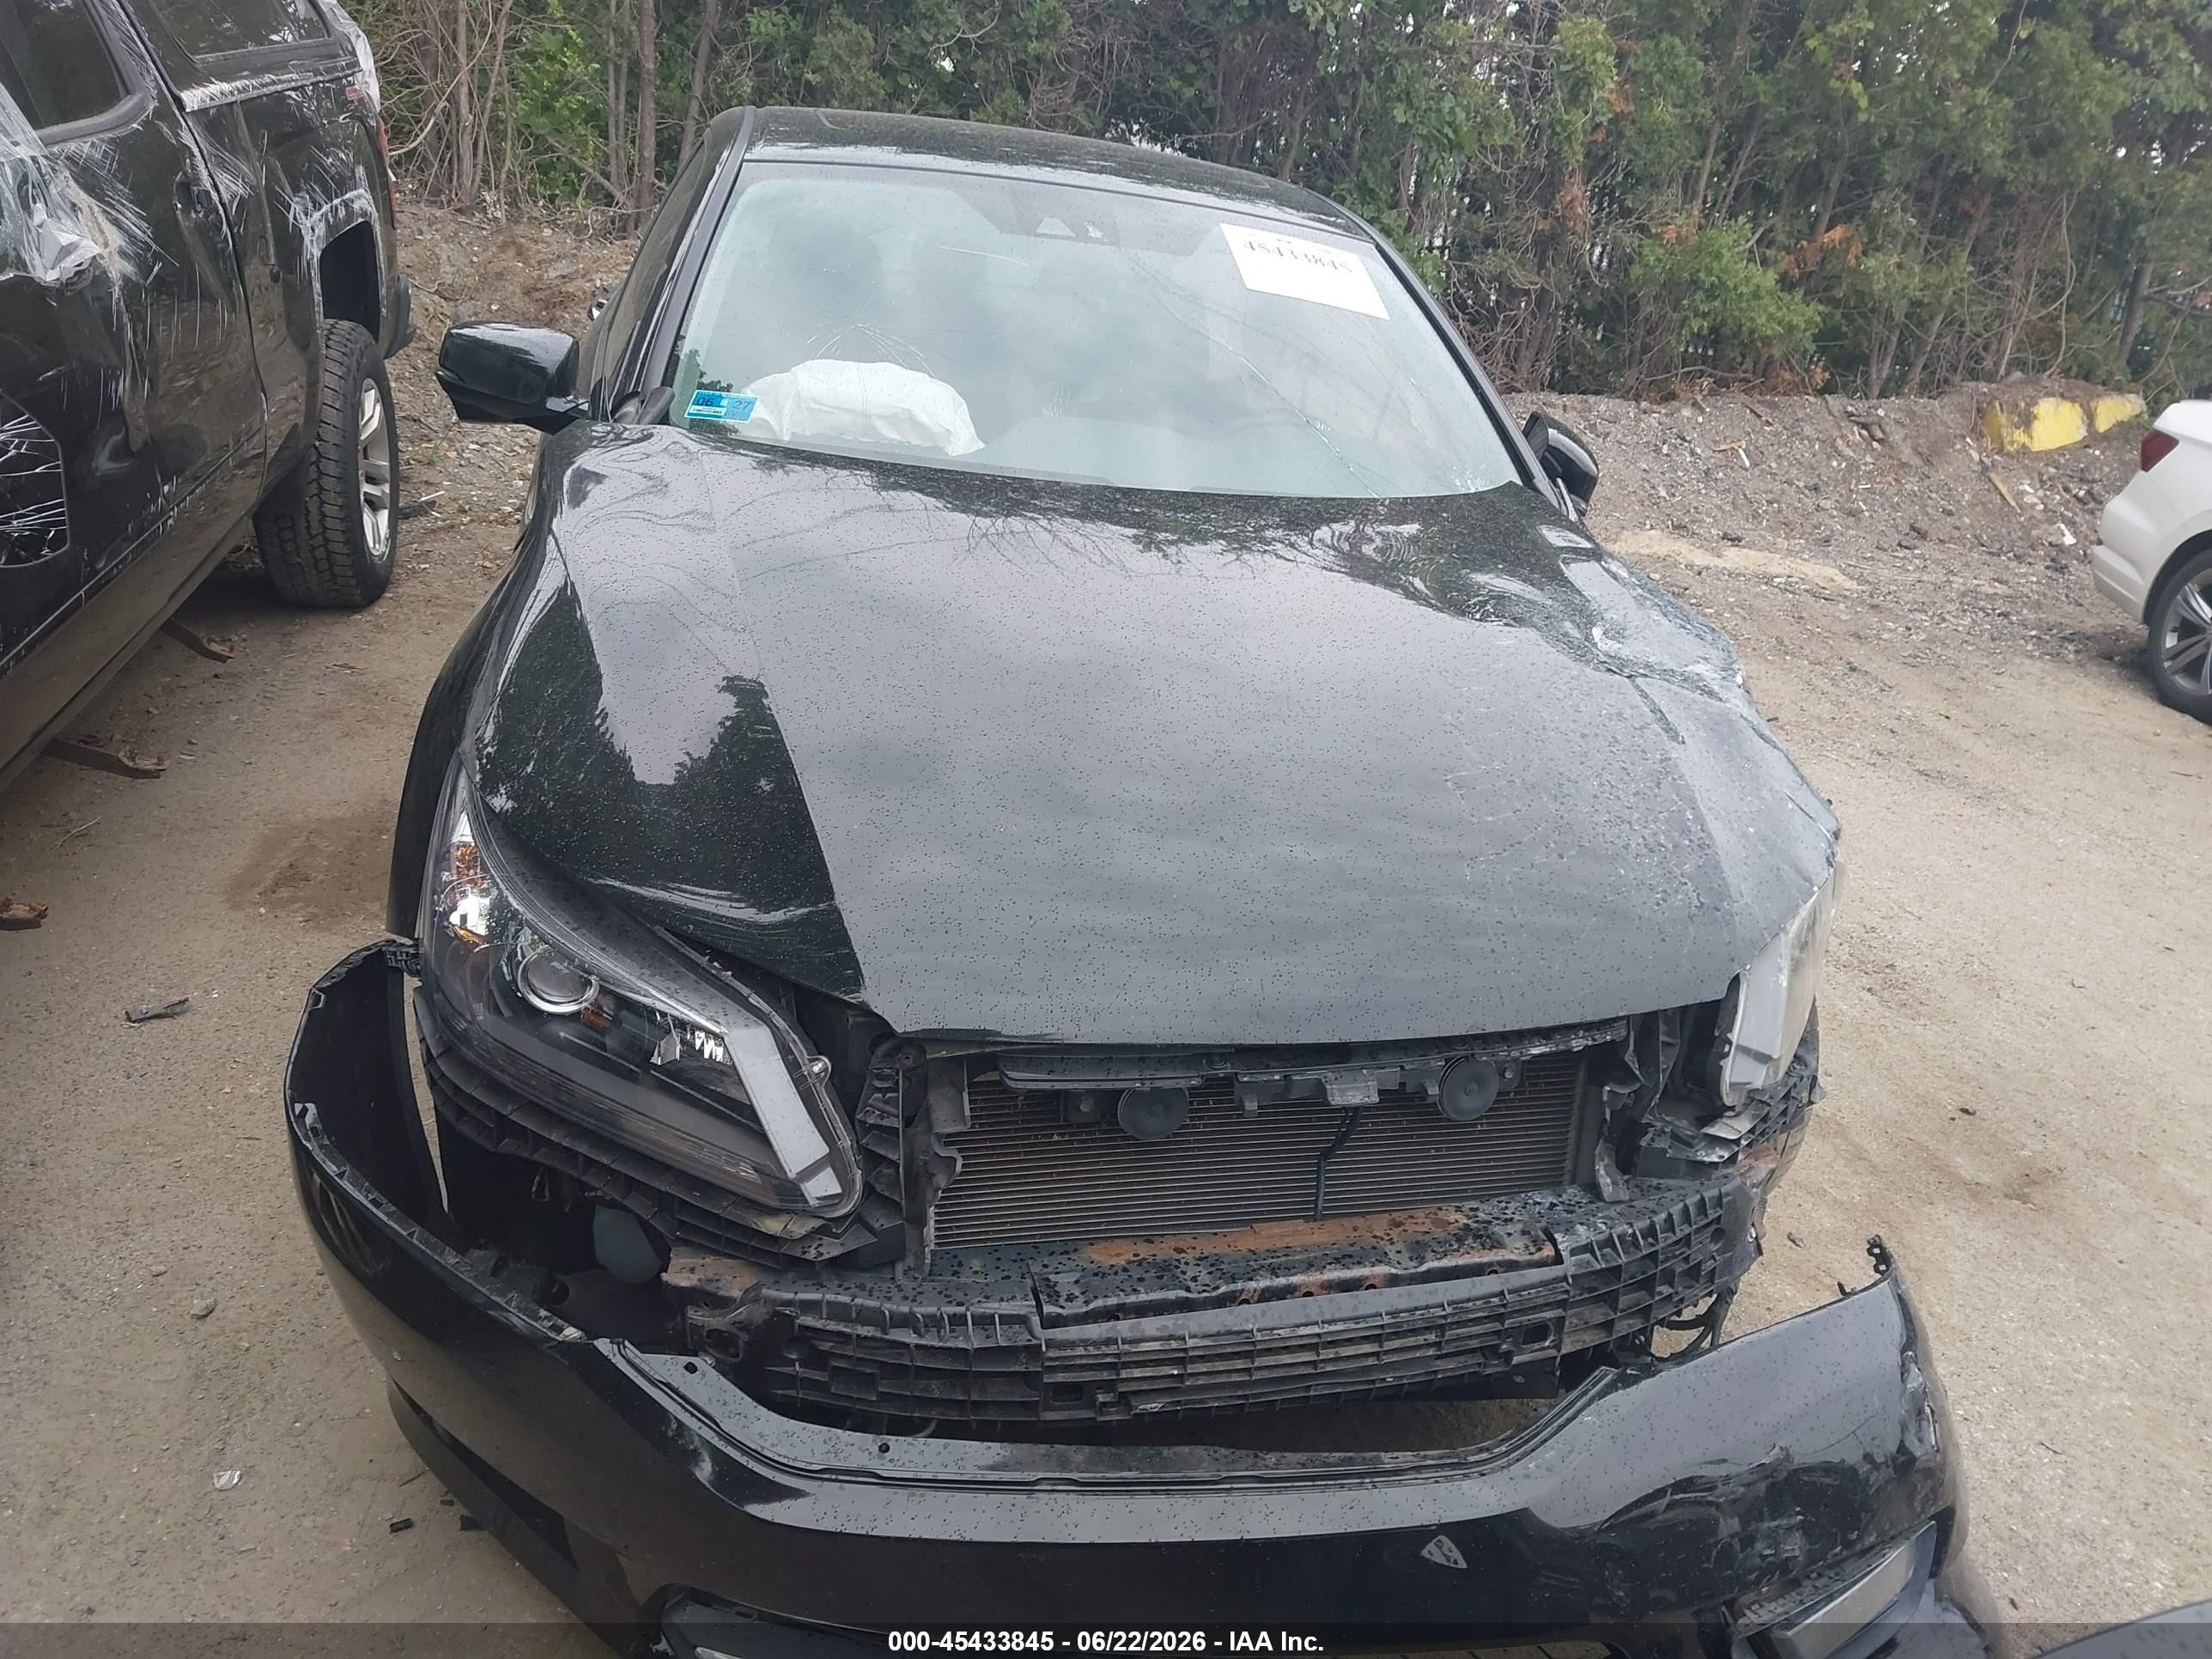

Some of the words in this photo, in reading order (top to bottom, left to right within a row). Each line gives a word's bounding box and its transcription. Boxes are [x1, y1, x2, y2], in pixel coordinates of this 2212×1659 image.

[1243, 240, 1353, 274] 454845
[696, 397, 714, 406] 06
[732, 400, 752, 410] 27
